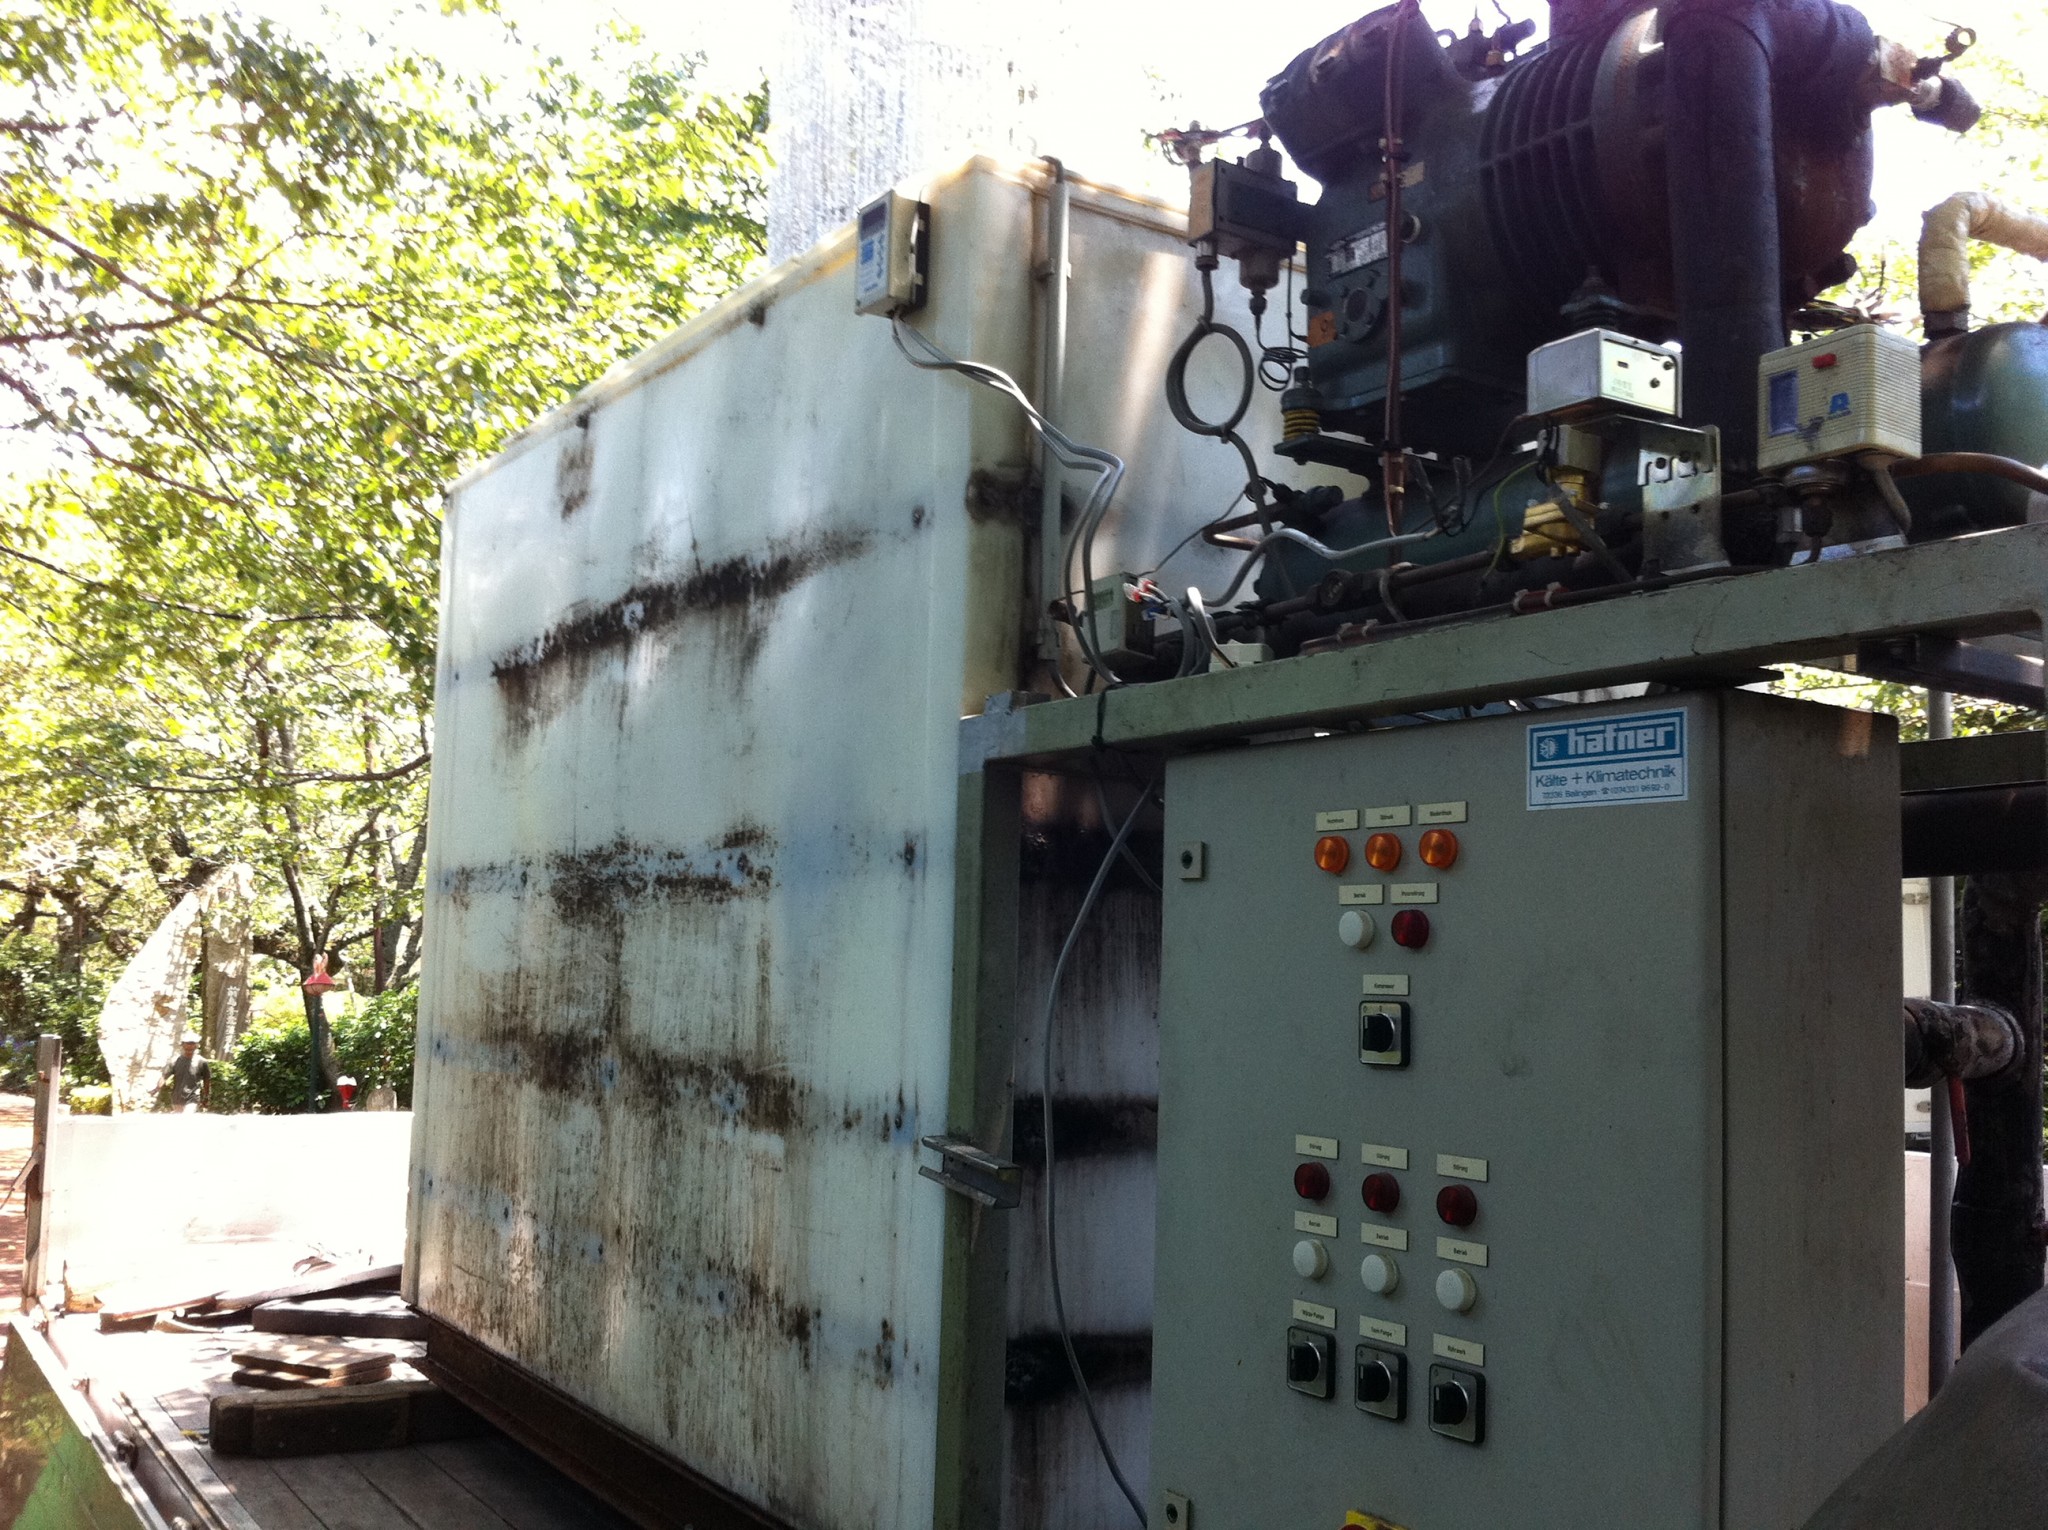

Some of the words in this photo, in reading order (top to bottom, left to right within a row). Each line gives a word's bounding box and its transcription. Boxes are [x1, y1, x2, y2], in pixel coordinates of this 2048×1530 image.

[1568, 723, 1674, 755] hafner
[1536, 774, 1568, 788] Kälte
[1586, 765, 1676, 784] Klimatechnik
